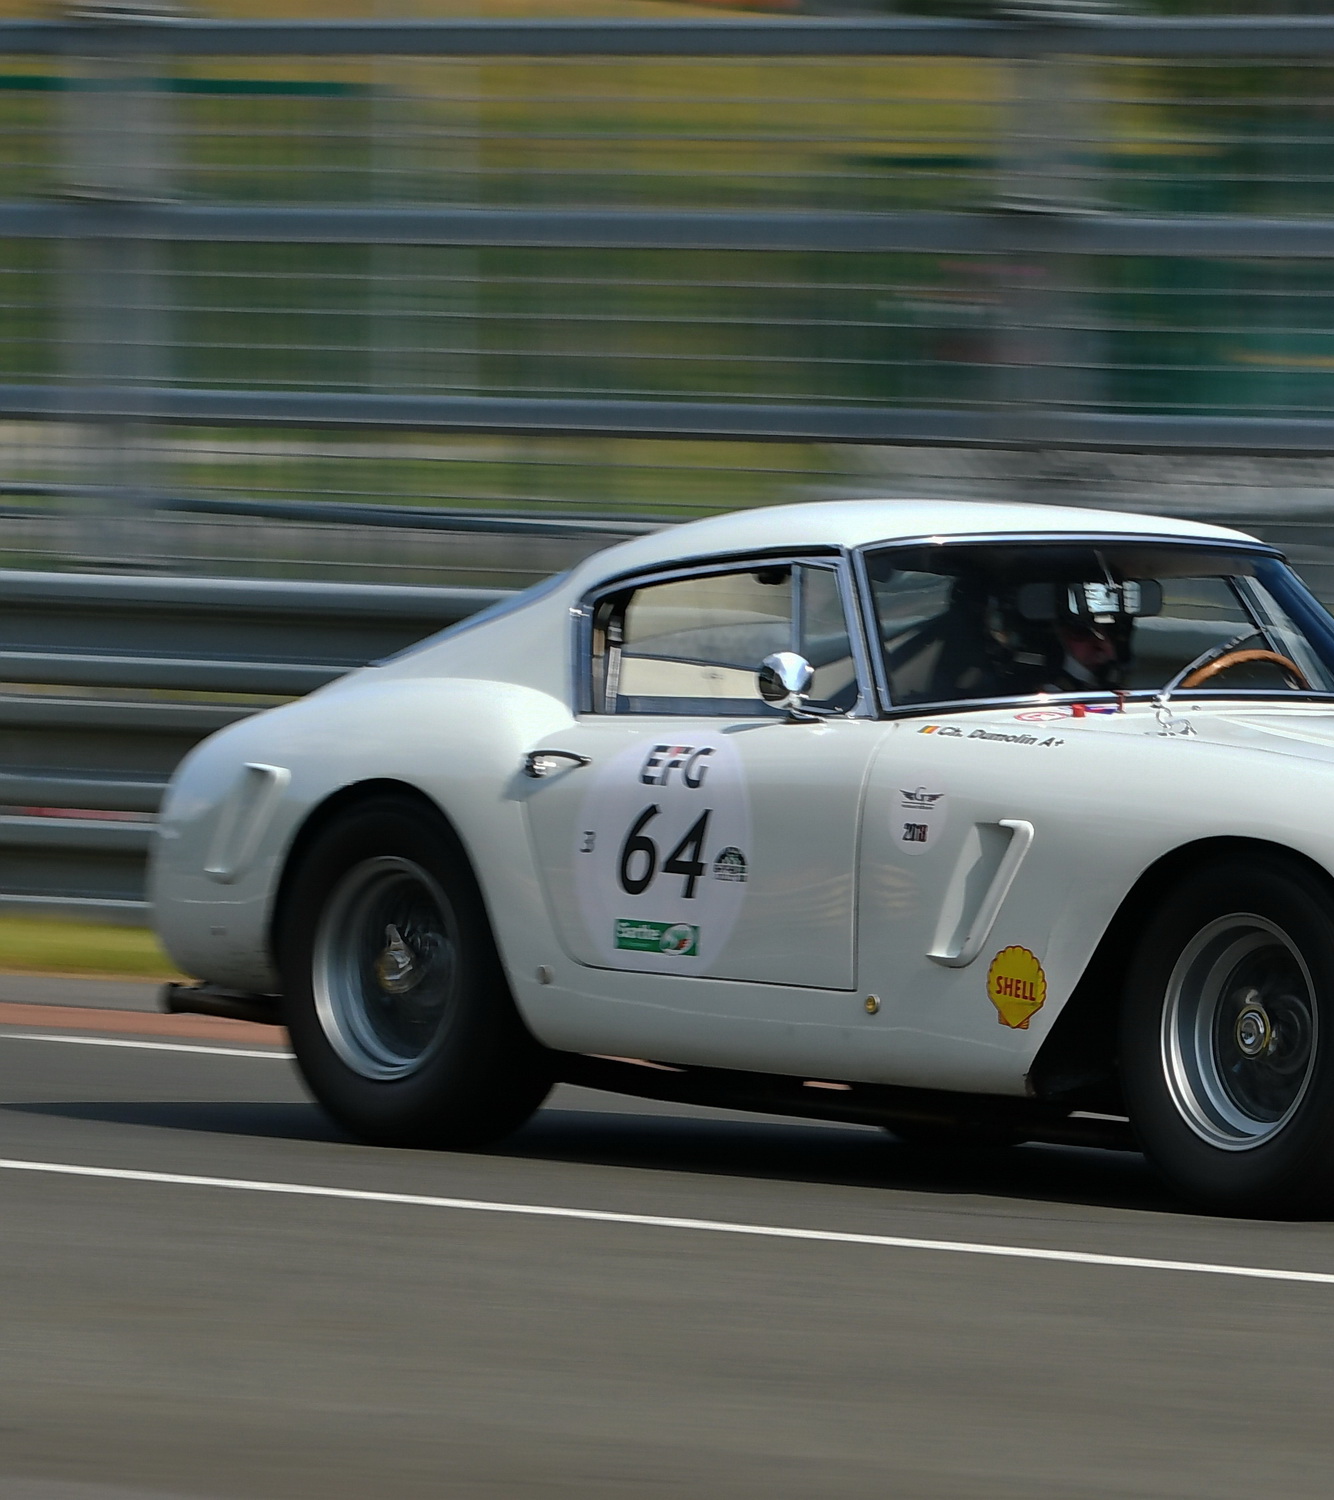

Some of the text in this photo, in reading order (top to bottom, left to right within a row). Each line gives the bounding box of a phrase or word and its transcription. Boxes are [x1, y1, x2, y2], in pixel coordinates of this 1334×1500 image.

[967, 729, 1039, 746] Dumolin
[638, 744, 717, 789] EFG
[616, 803, 714, 899] 64
[995, 975, 1036, 1002] SHELL
